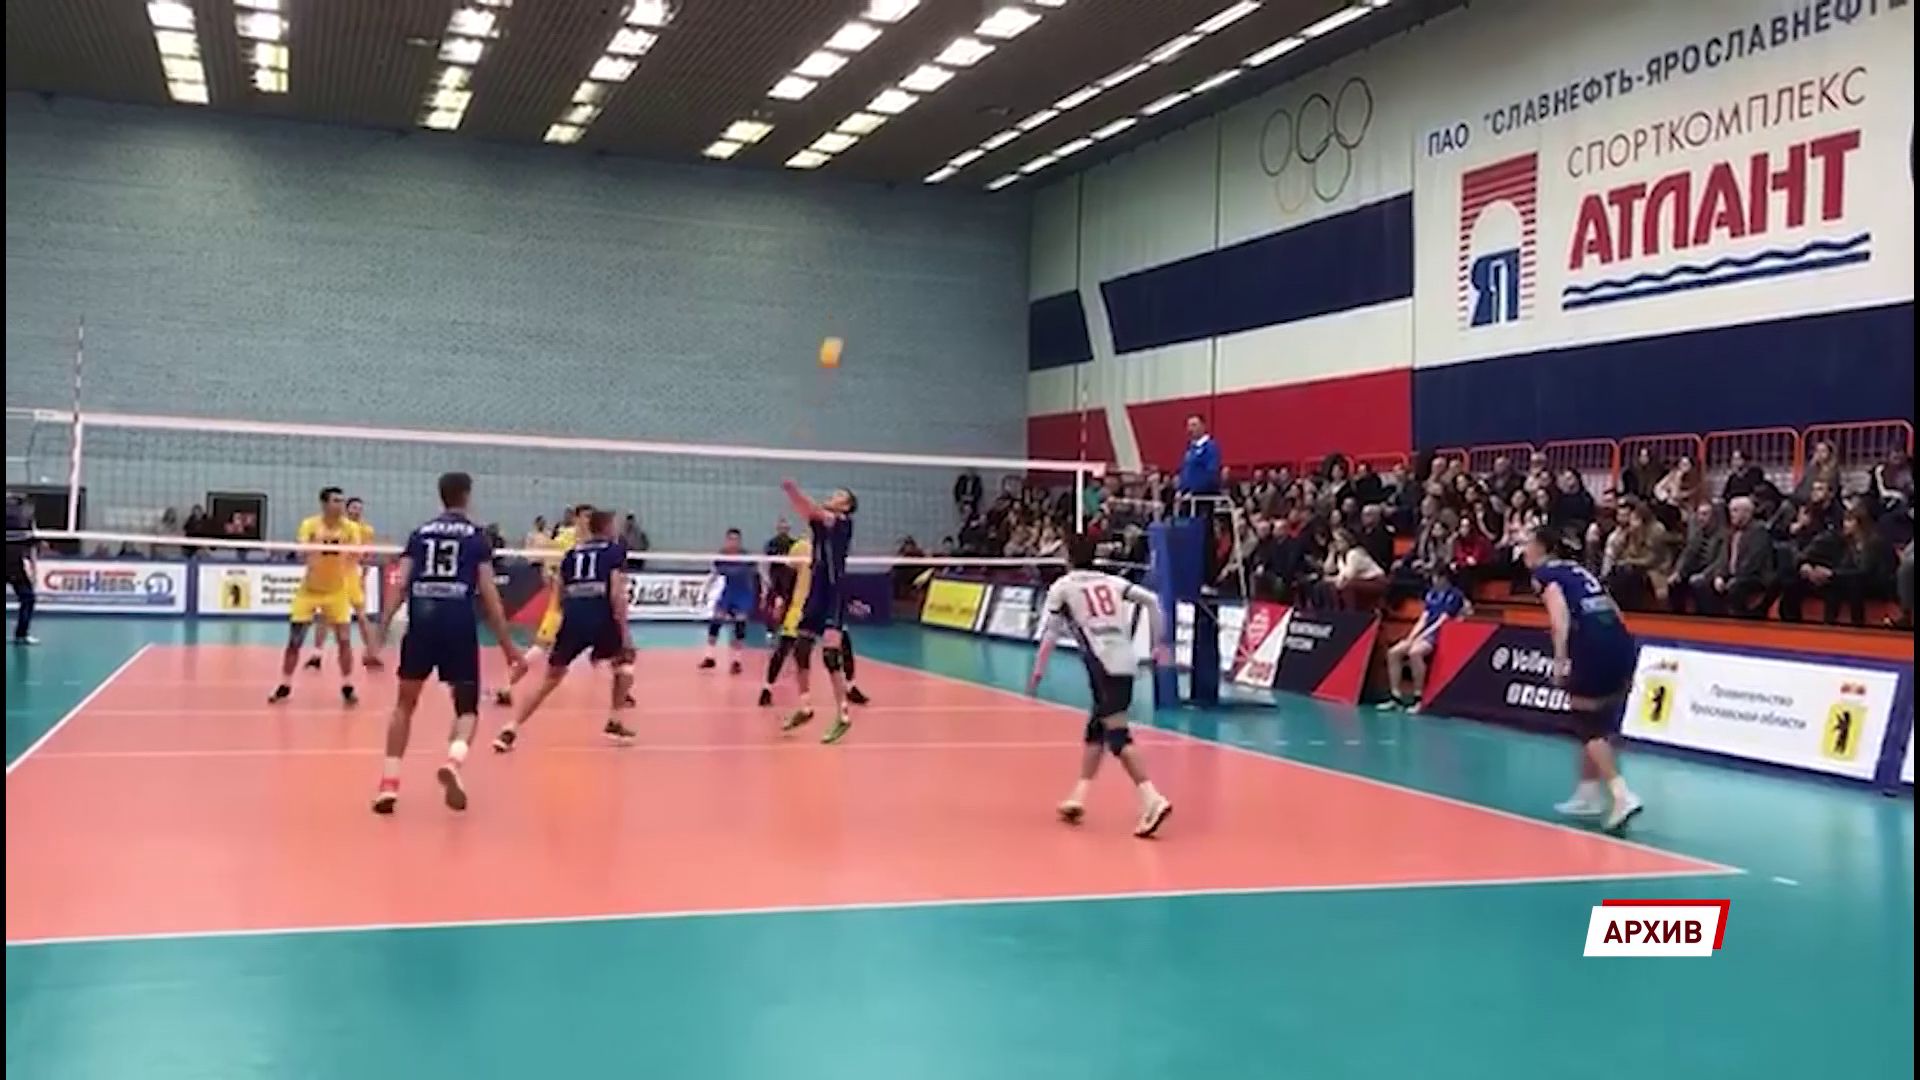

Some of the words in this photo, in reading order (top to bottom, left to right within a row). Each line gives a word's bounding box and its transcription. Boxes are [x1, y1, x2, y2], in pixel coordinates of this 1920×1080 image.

[1427, 122, 1471, 157] ПАО
[1567, 66, 1869, 178] СПОРТКОМПЛЕКС
[1568, 129, 1863, 271] АТЛАНТ
[420, 538, 460, 577] 13
[573, 550, 598, 580] 11
[1082, 584, 1116, 617] 18
